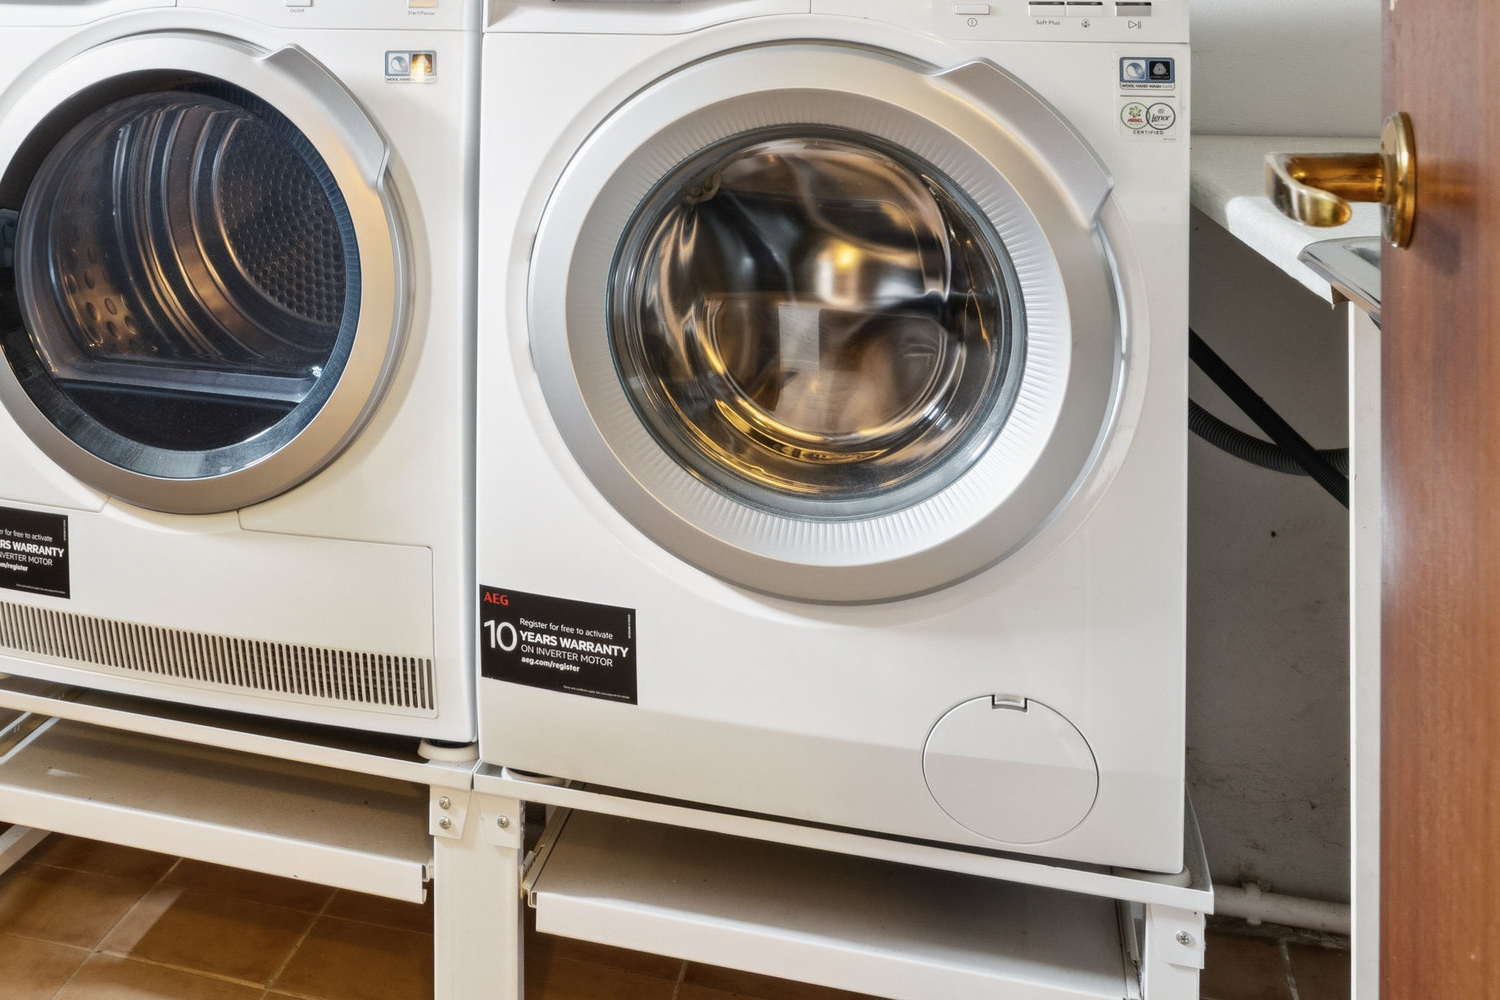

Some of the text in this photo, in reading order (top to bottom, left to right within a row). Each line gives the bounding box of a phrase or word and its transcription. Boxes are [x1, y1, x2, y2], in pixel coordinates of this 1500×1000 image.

[1151, 114, 1172, 123] Lenor
[4, 528, 12, 536] for
[13, 530, 24, 538] free
[31, 533, 53, 543] activate
[12, 541, 64, 558] WARRANTY
[28, 556, 53, 566] MOTOR
[483, 592, 509, 606] AEG
[483, 619, 517, 652] 10
[520, 617, 614, 640] Register for free to activate
[519, 630, 629, 658] YEARS WARRANTY
[521, 644, 614, 668] ON INVERTER MOTOR
[521, 656, 580, 672] aeg.com/register
